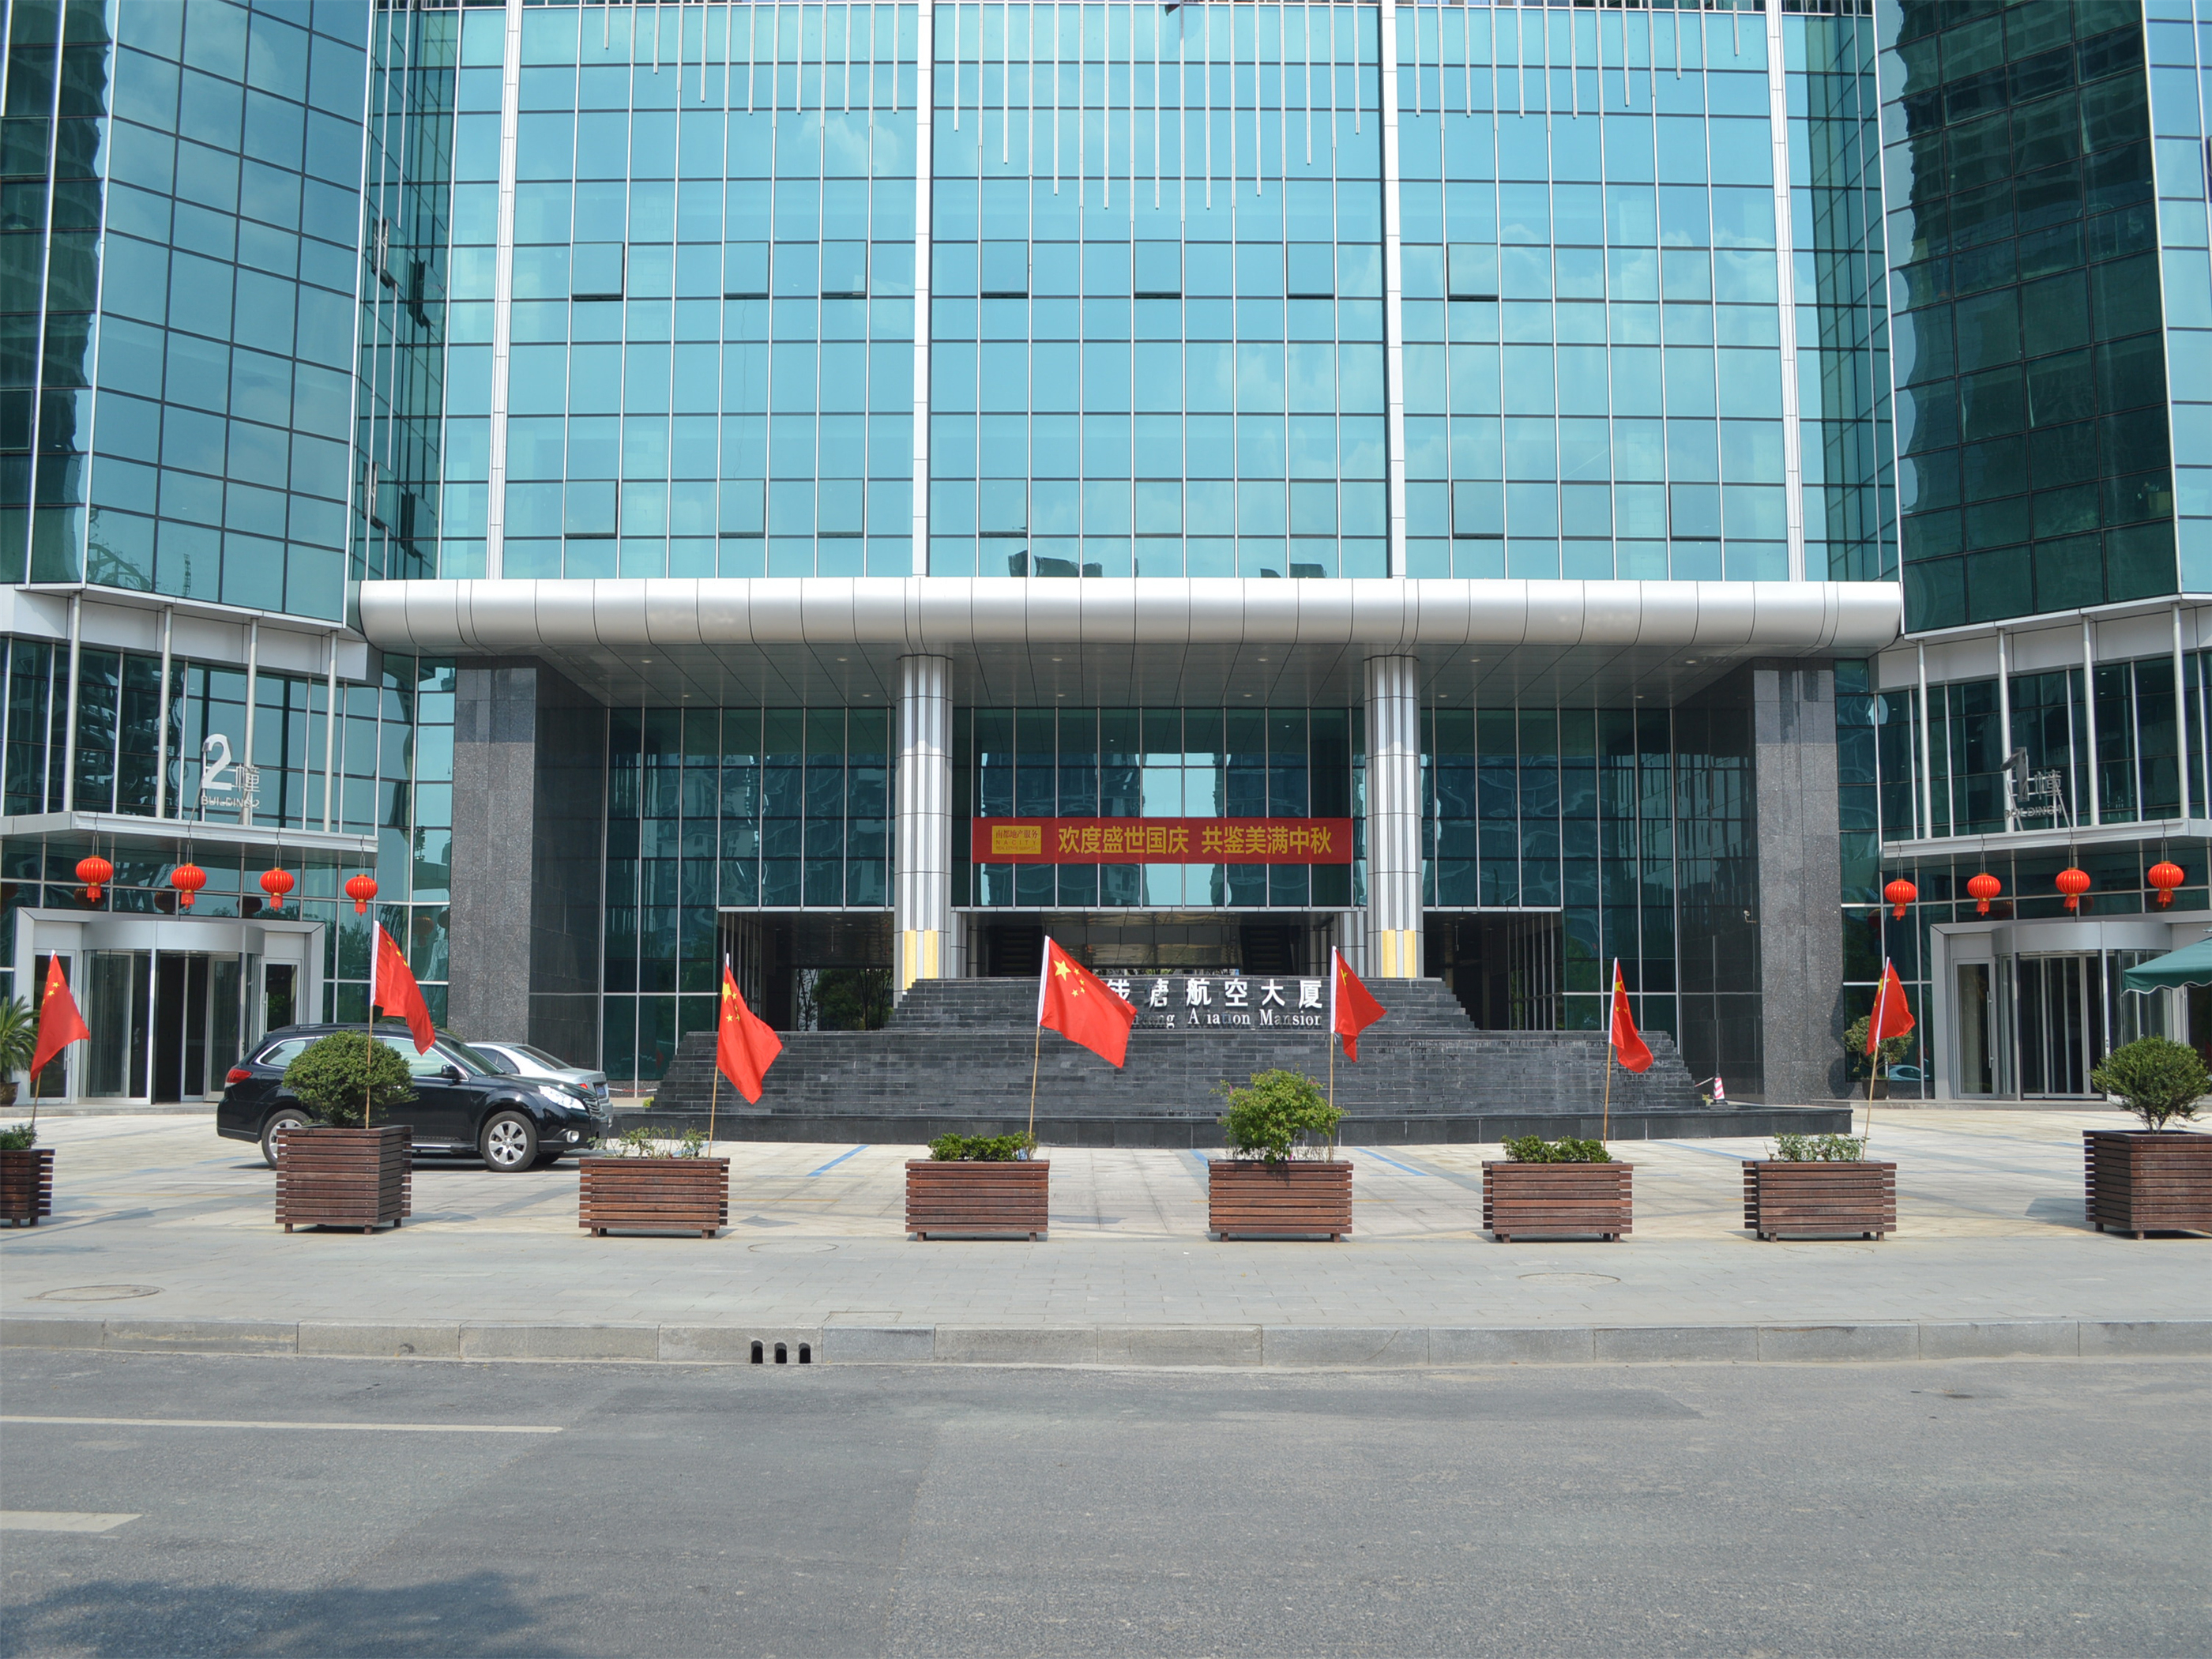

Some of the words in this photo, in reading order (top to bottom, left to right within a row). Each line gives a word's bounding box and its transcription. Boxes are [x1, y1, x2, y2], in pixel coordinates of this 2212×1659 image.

[1058, 826, 1190, 855] 欢度盛世国庆
[1201, 826, 1332, 855] 共鉴美满中秋
[1187, 1007, 1251, 1025] Aviation
[1259, 1009, 1322, 1026] Mansion
